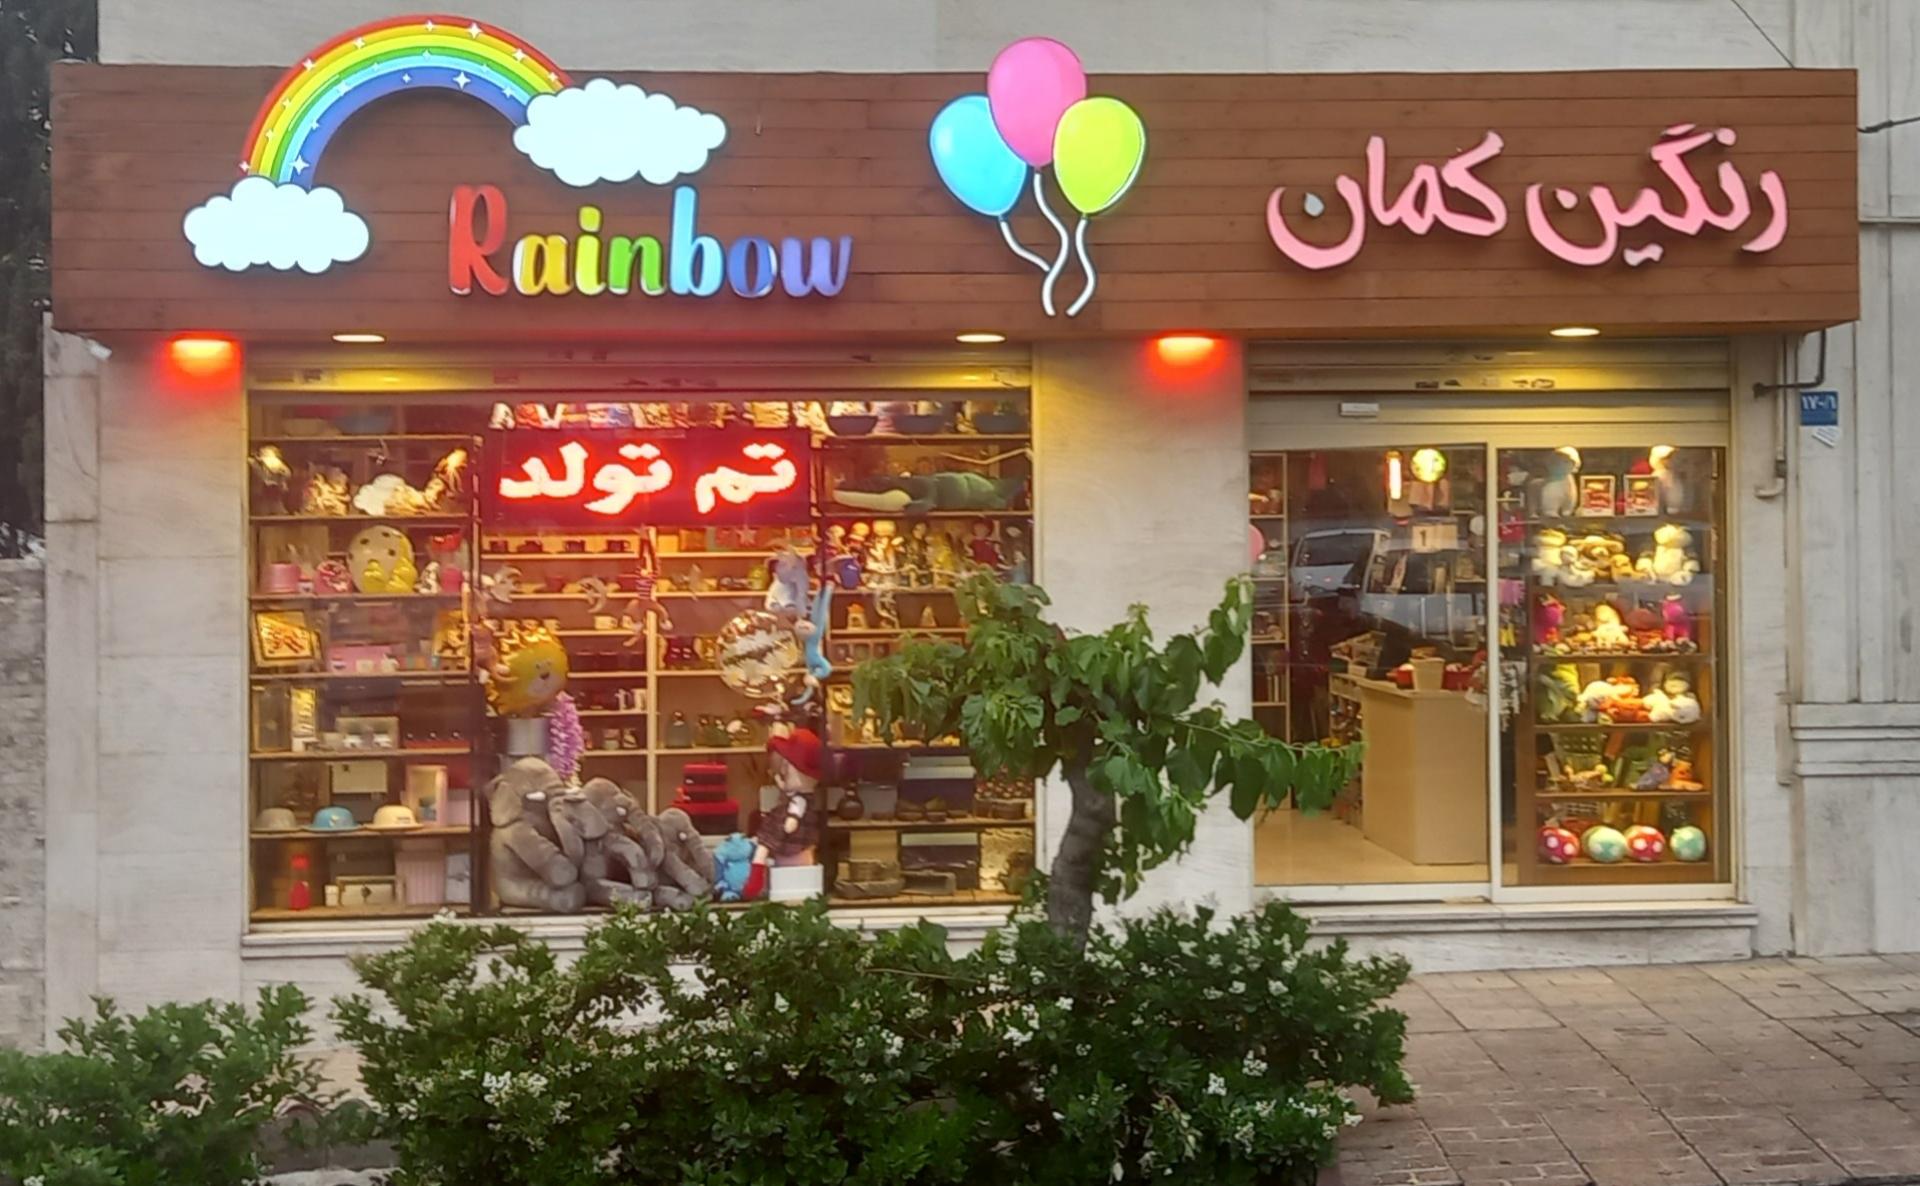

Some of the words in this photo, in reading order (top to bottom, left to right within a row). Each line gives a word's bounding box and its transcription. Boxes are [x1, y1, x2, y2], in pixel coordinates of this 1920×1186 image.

[448, 184, 853, 297] Rainbow
[1266, 130, 1508, 269] کمان
[1525, 123, 1789, 266] رنگین
[500, 440, 673, 514] تولد
[695, 442, 797, 514] تم
